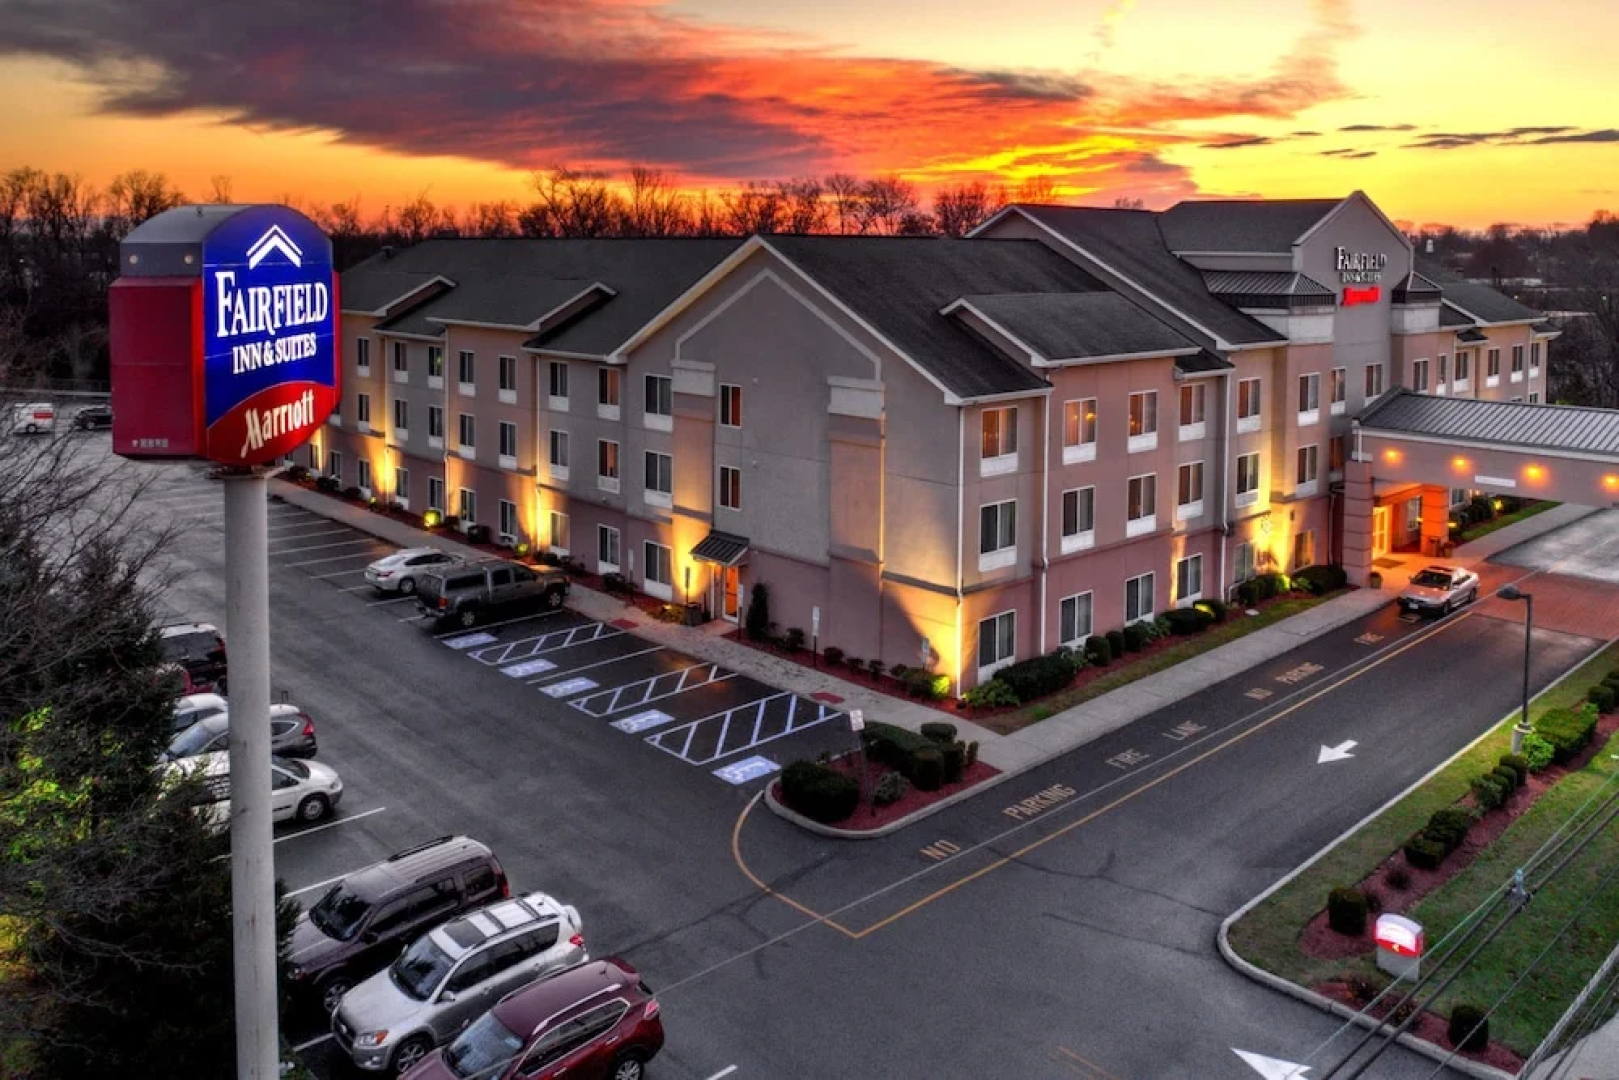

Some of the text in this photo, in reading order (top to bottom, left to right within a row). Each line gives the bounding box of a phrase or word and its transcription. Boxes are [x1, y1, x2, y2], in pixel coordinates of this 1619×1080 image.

[215, 271, 328, 338] FAIRFIELD
[240, 389, 315, 459] Marriott
[919, 720, 1207, 861] NO PARKING FIRE LANE
